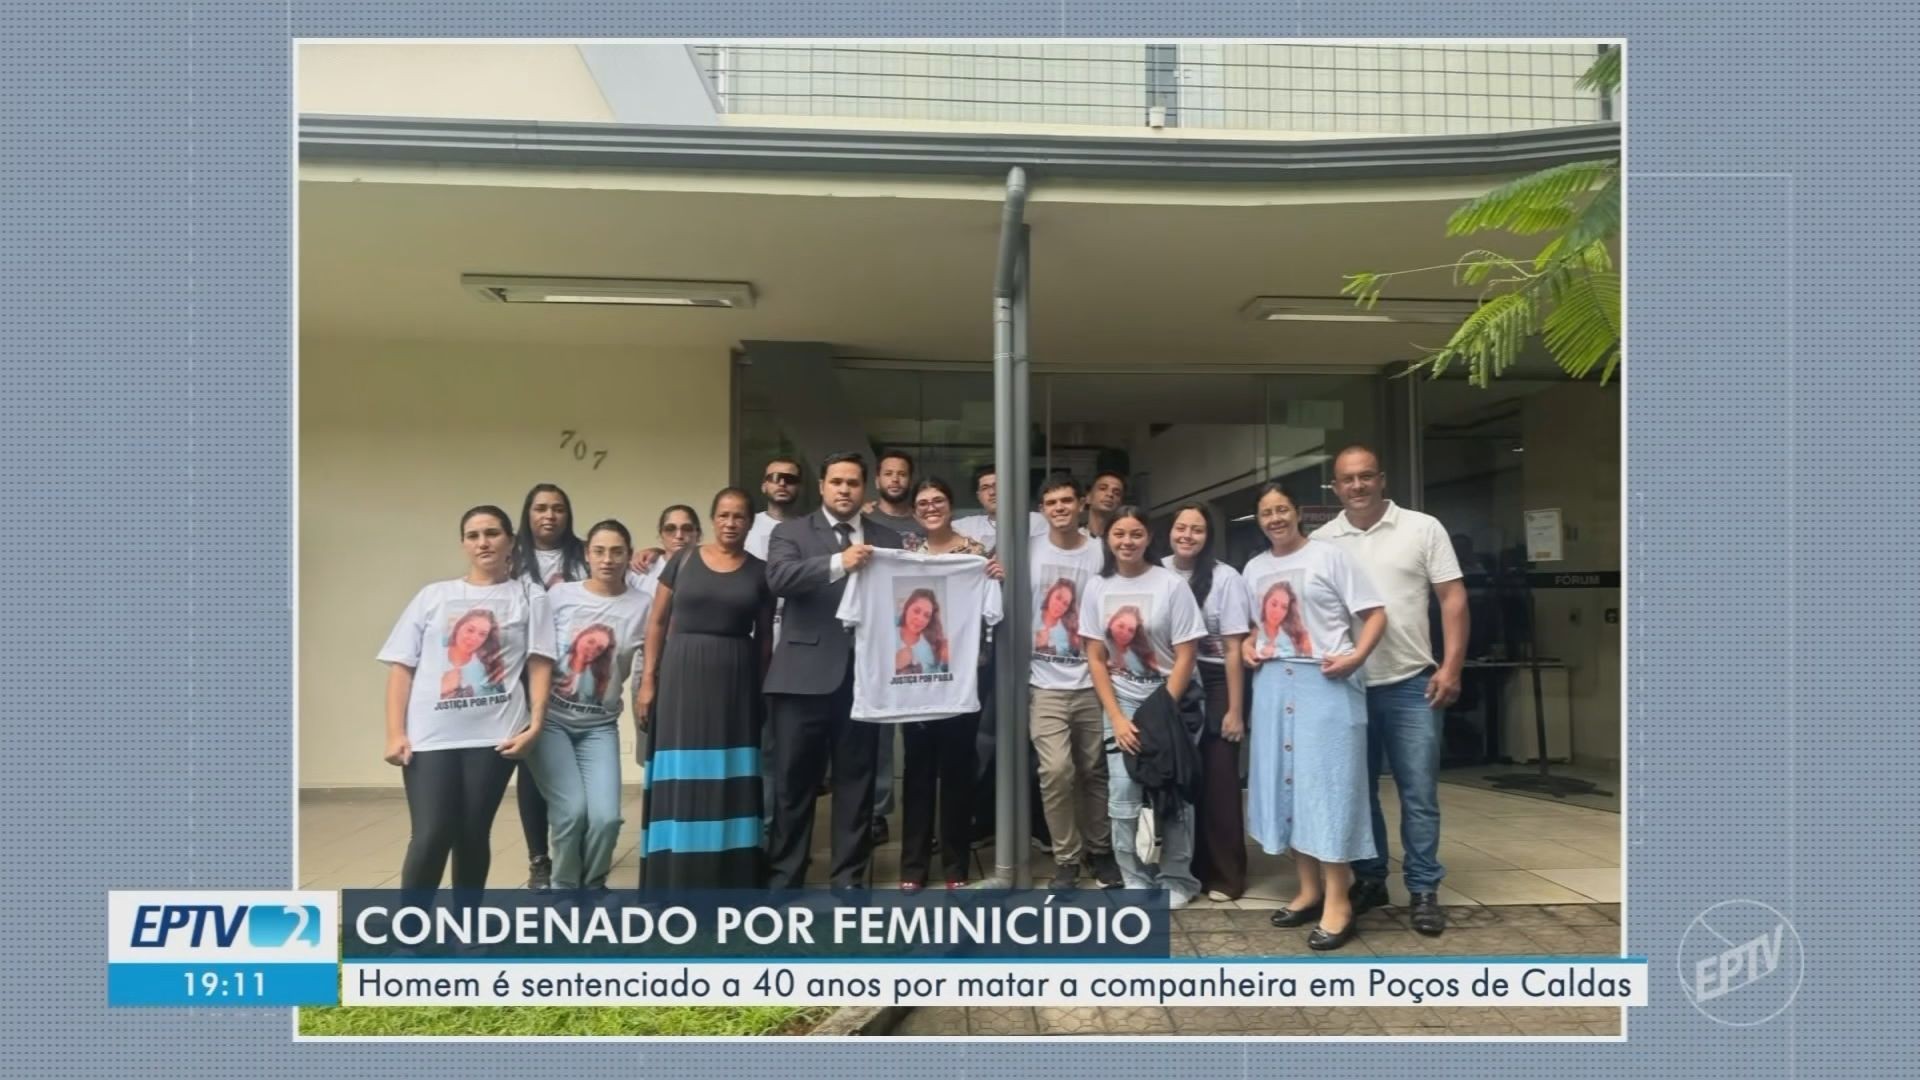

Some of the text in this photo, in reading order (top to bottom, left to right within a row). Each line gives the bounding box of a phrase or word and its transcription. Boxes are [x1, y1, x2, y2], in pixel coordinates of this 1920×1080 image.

[559, 429, 608, 470] 707
[919, 674, 932, 683] POR
[434, 700, 469, 711] JUSTIÇA
[470, 697, 488, 707] POR
